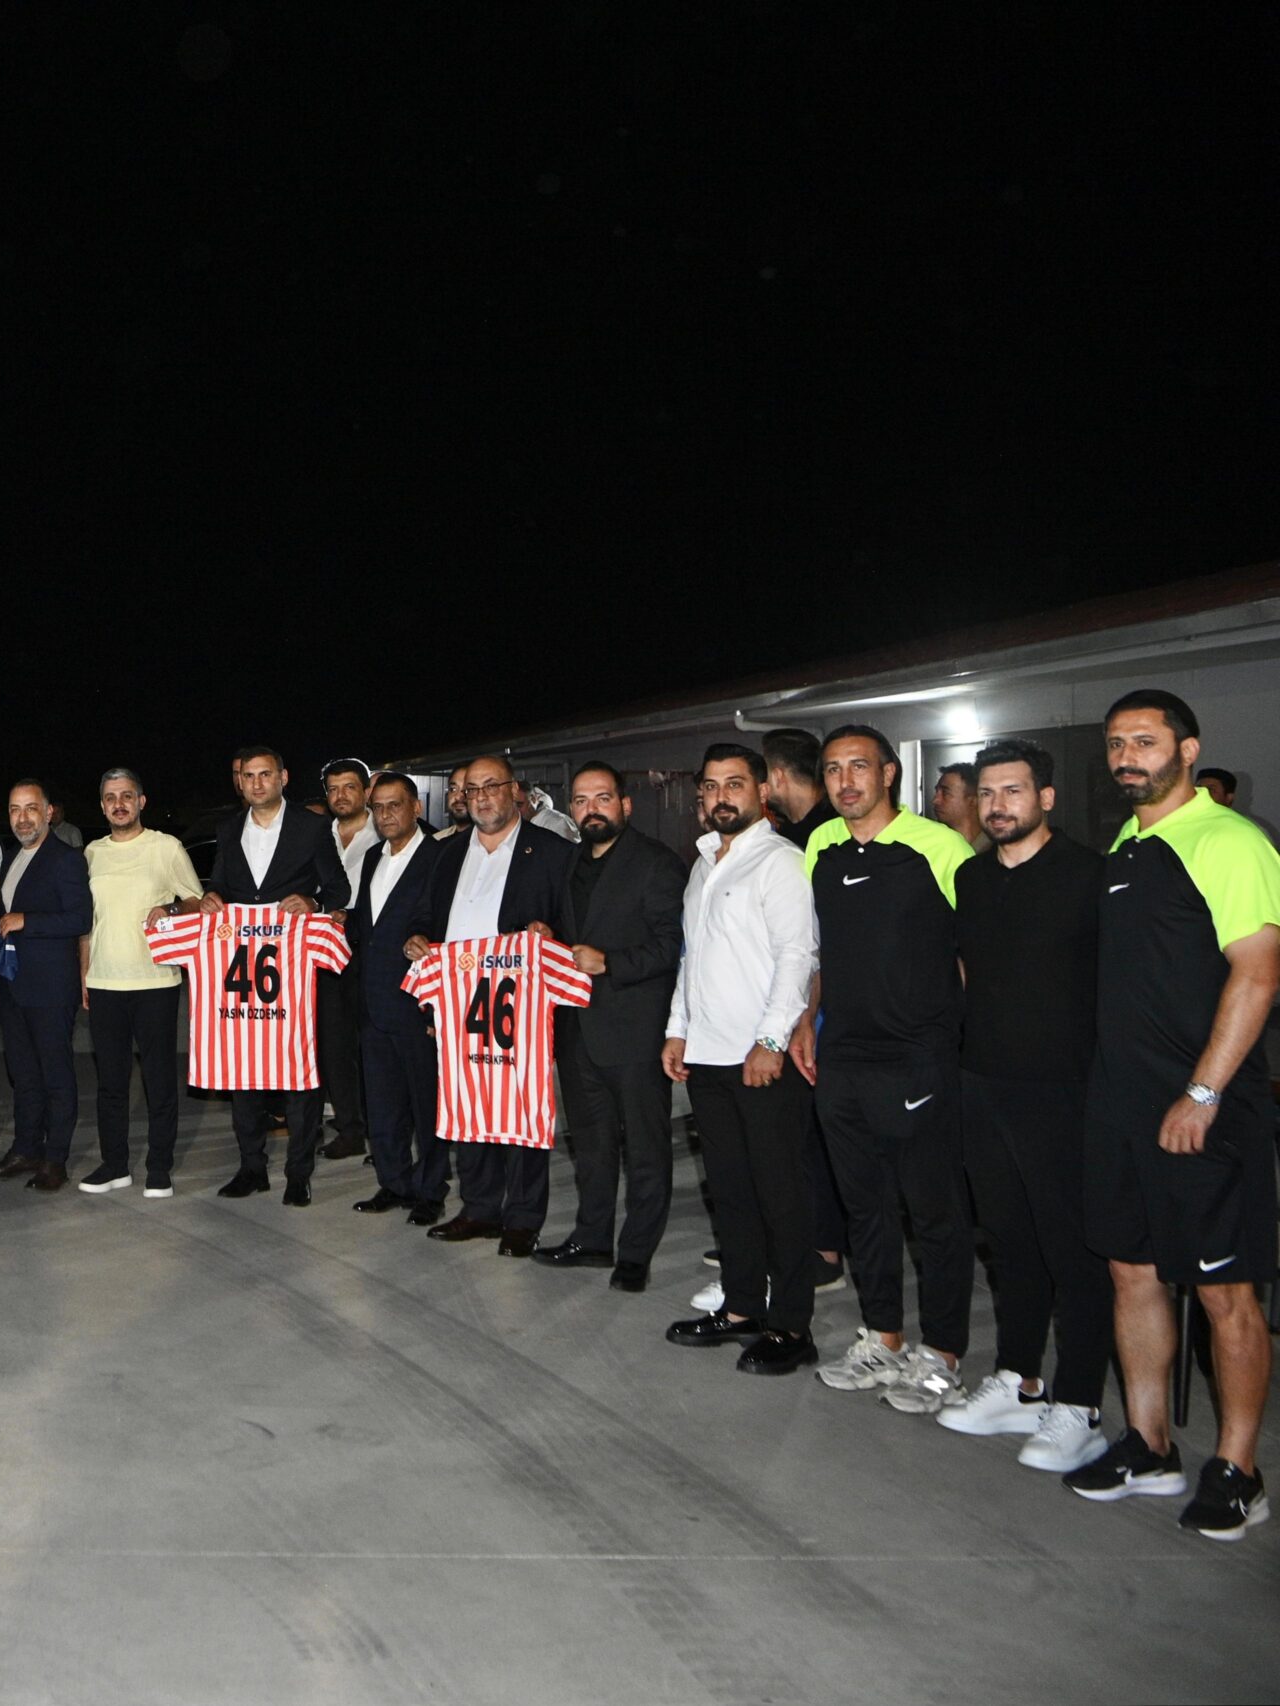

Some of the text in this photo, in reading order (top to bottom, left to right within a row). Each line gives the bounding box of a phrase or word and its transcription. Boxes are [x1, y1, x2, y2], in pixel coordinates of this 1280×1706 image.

[224, 944, 281, 1004] 46
[219, 1006, 286, 1020] YASİN ÖZDEMİR
[465, 977, 516, 1049] 46
